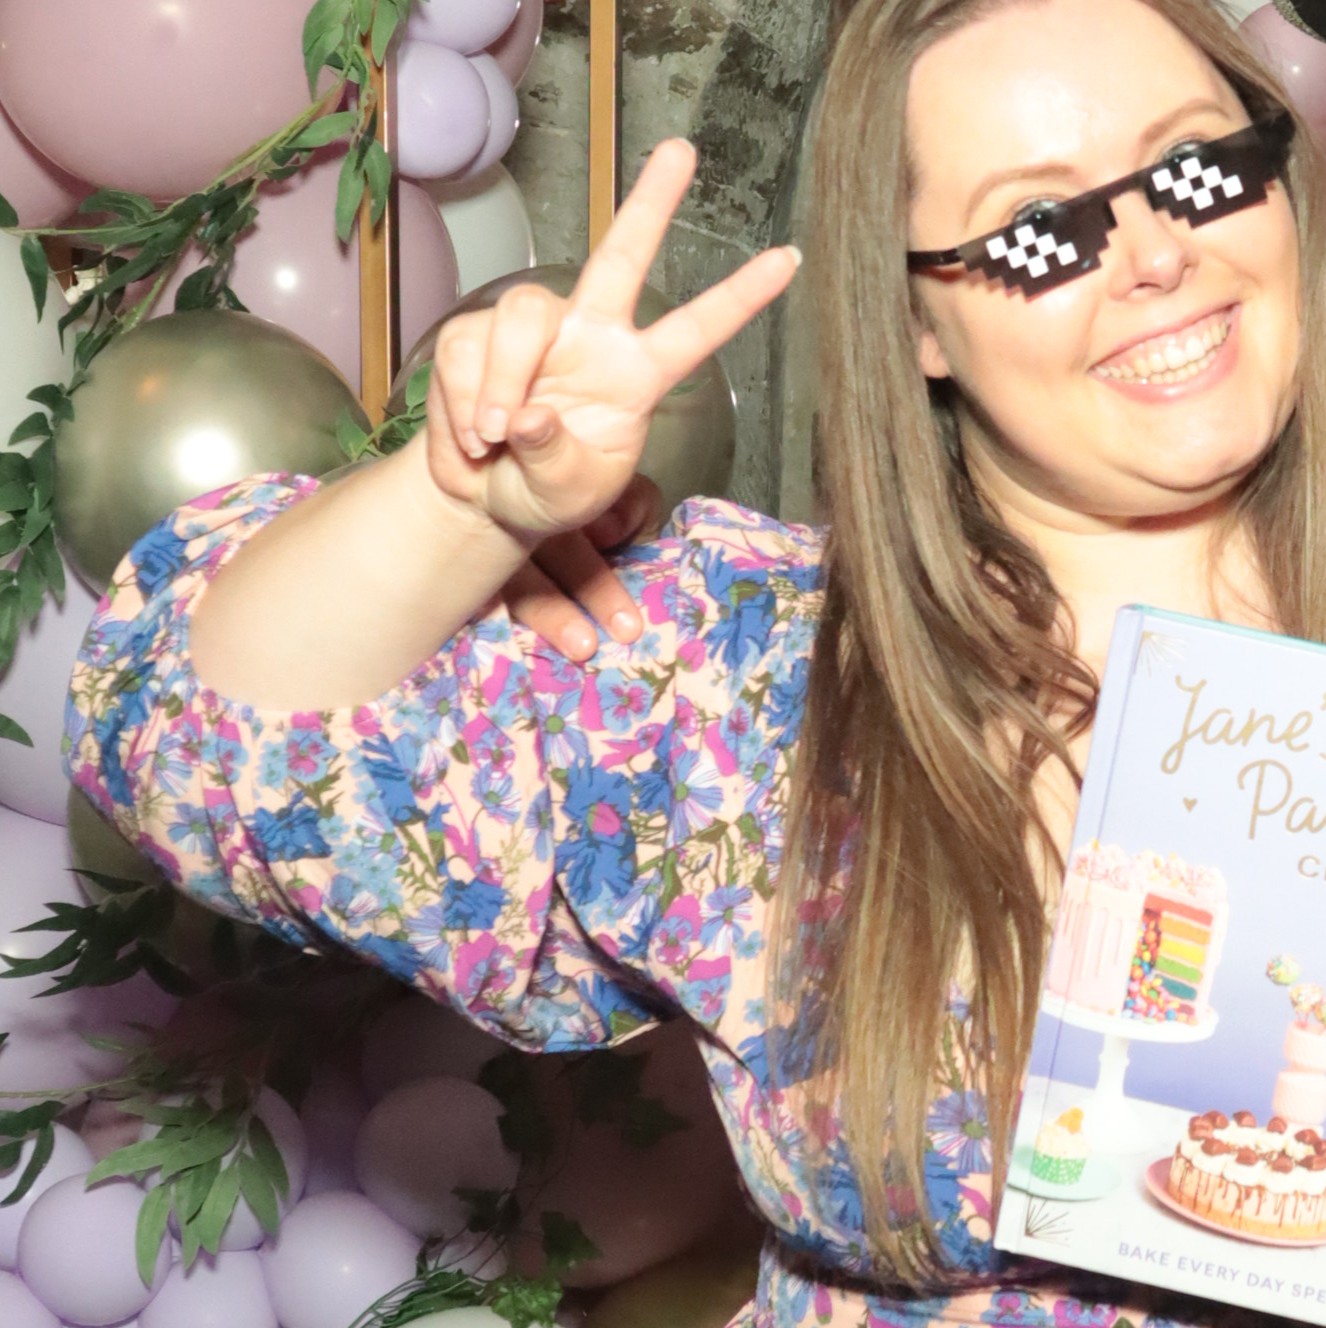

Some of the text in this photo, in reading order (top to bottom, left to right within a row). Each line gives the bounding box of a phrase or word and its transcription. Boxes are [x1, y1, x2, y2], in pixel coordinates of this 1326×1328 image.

[1117, 1242, 1170, 1266] BAKE
[1177, 1256, 1240, 1284] EVERY
[1246, 1272, 1285, 1293] DAY
